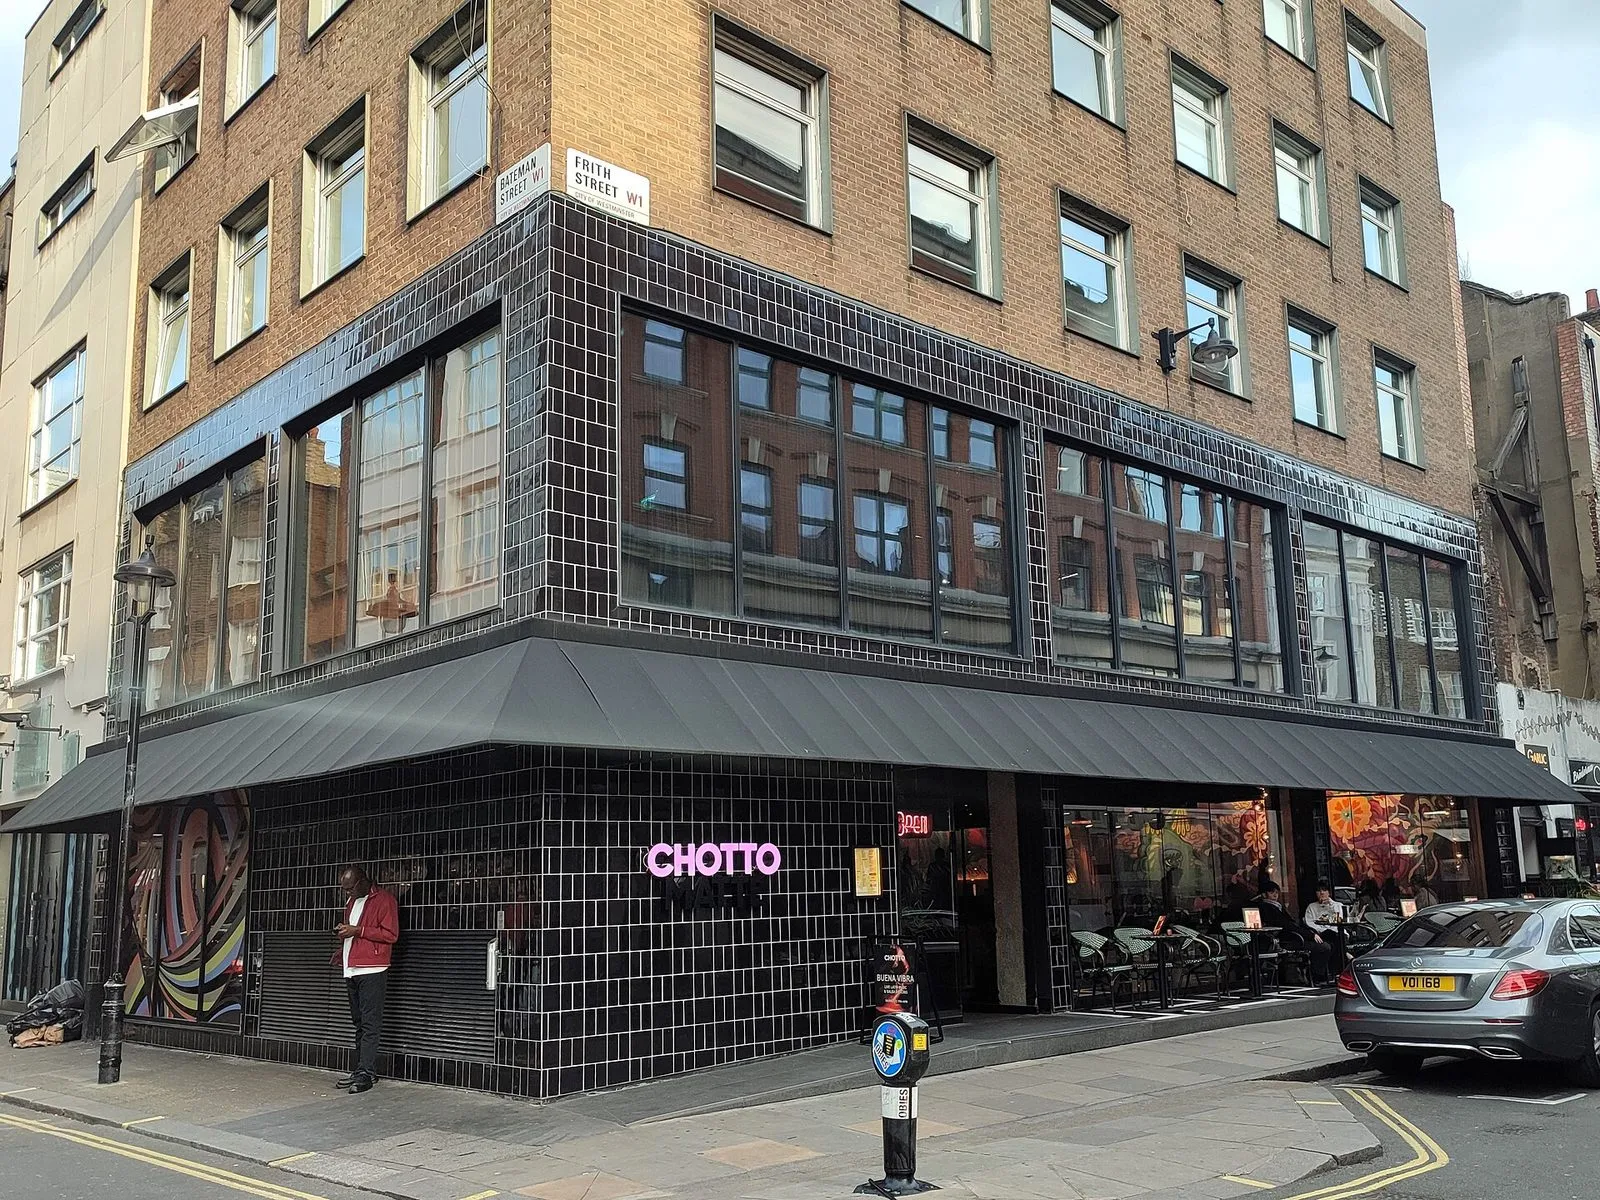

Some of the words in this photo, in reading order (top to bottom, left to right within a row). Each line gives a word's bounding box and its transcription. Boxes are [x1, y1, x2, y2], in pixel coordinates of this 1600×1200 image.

[500, 156, 537, 191] BATEMAN
[575, 155, 611, 180] FRITH
[500, 178, 527, 206] STREET
[532, 166, 544, 184] W1
[575, 171, 619, 198] STREET
[626, 190, 643, 208] W1
[574, 191, 587, 201] CITY
[587, 195, 595, 204] OF
[596, 199, 635, 219] WESTMINSTER
[647, 842, 782, 878] CHOTTO
[883, 954, 906, 962] CHOTTO
[876, 973, 896, 983] BUENA
[897, 973, 915, 983] VIBRA
[898, 1088, 909, 1118] OBIES
